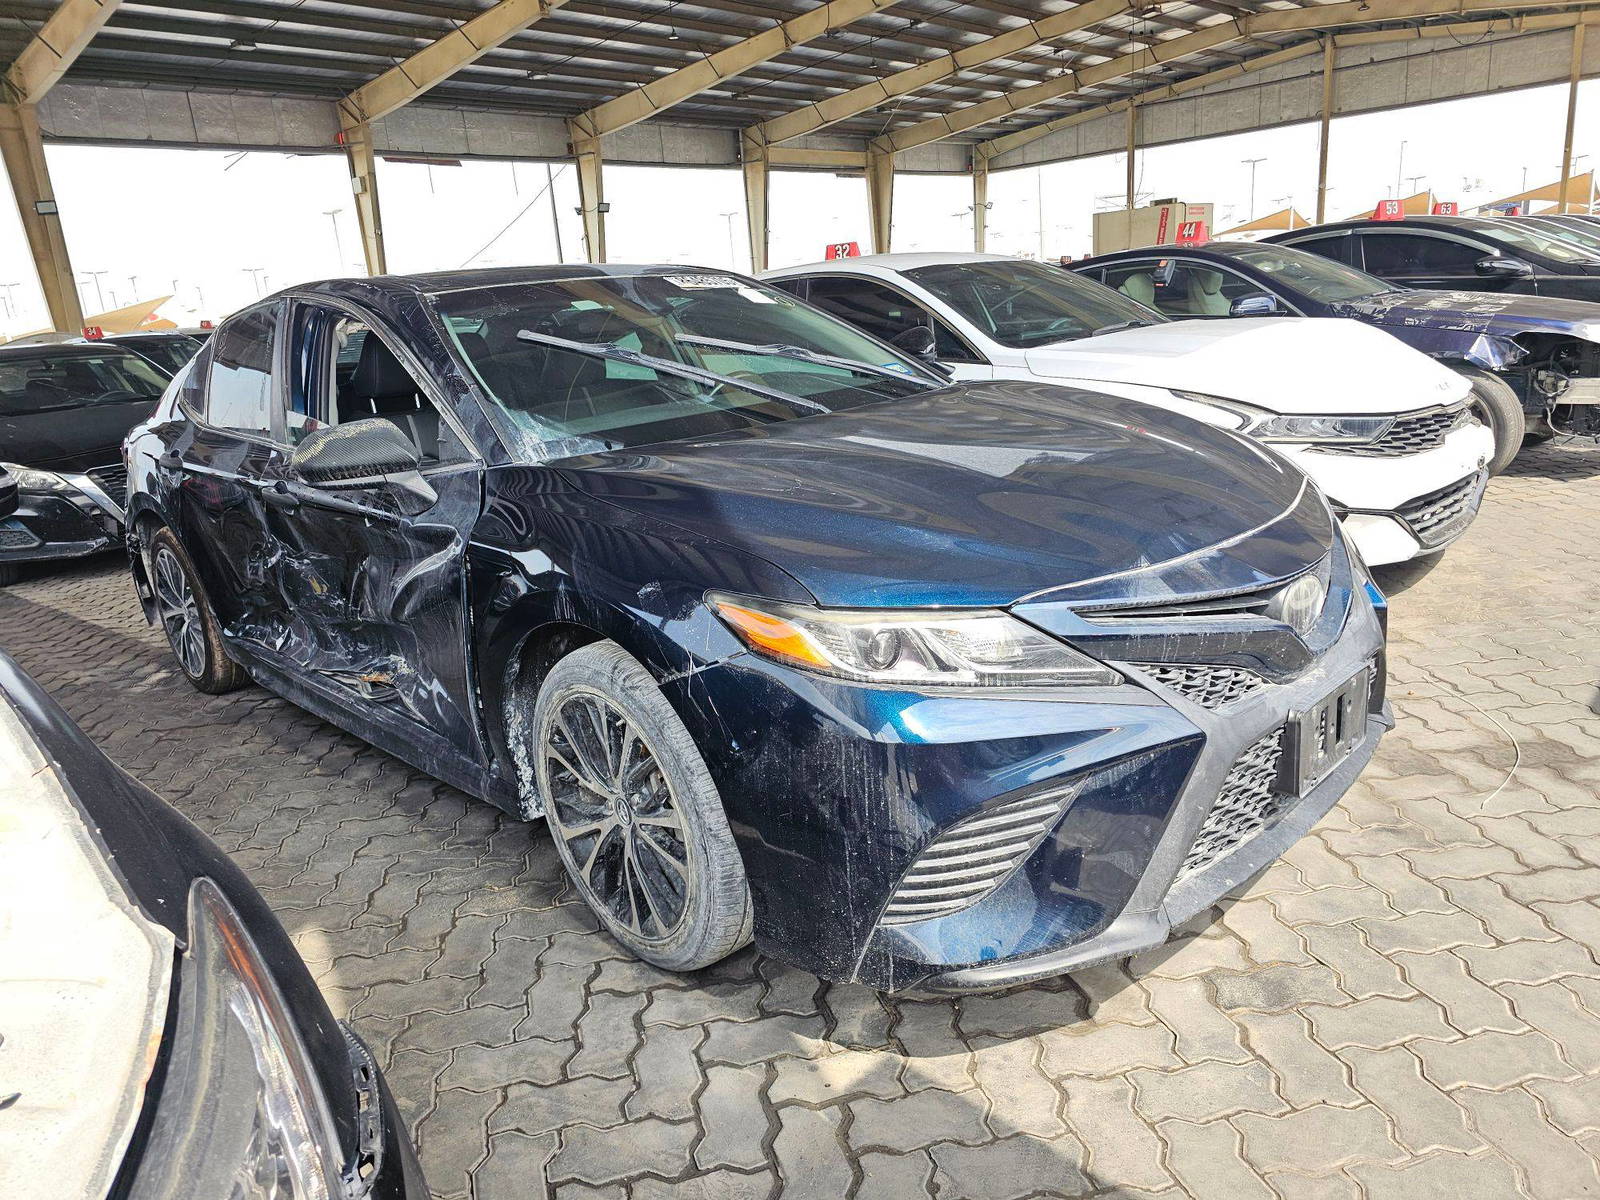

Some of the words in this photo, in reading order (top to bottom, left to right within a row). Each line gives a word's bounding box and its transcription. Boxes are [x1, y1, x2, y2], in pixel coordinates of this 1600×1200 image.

[1386, 201, 1398, 214] 53
[1182, 223, 1196, 237] 44
[835, 244, 850, 259] 32
